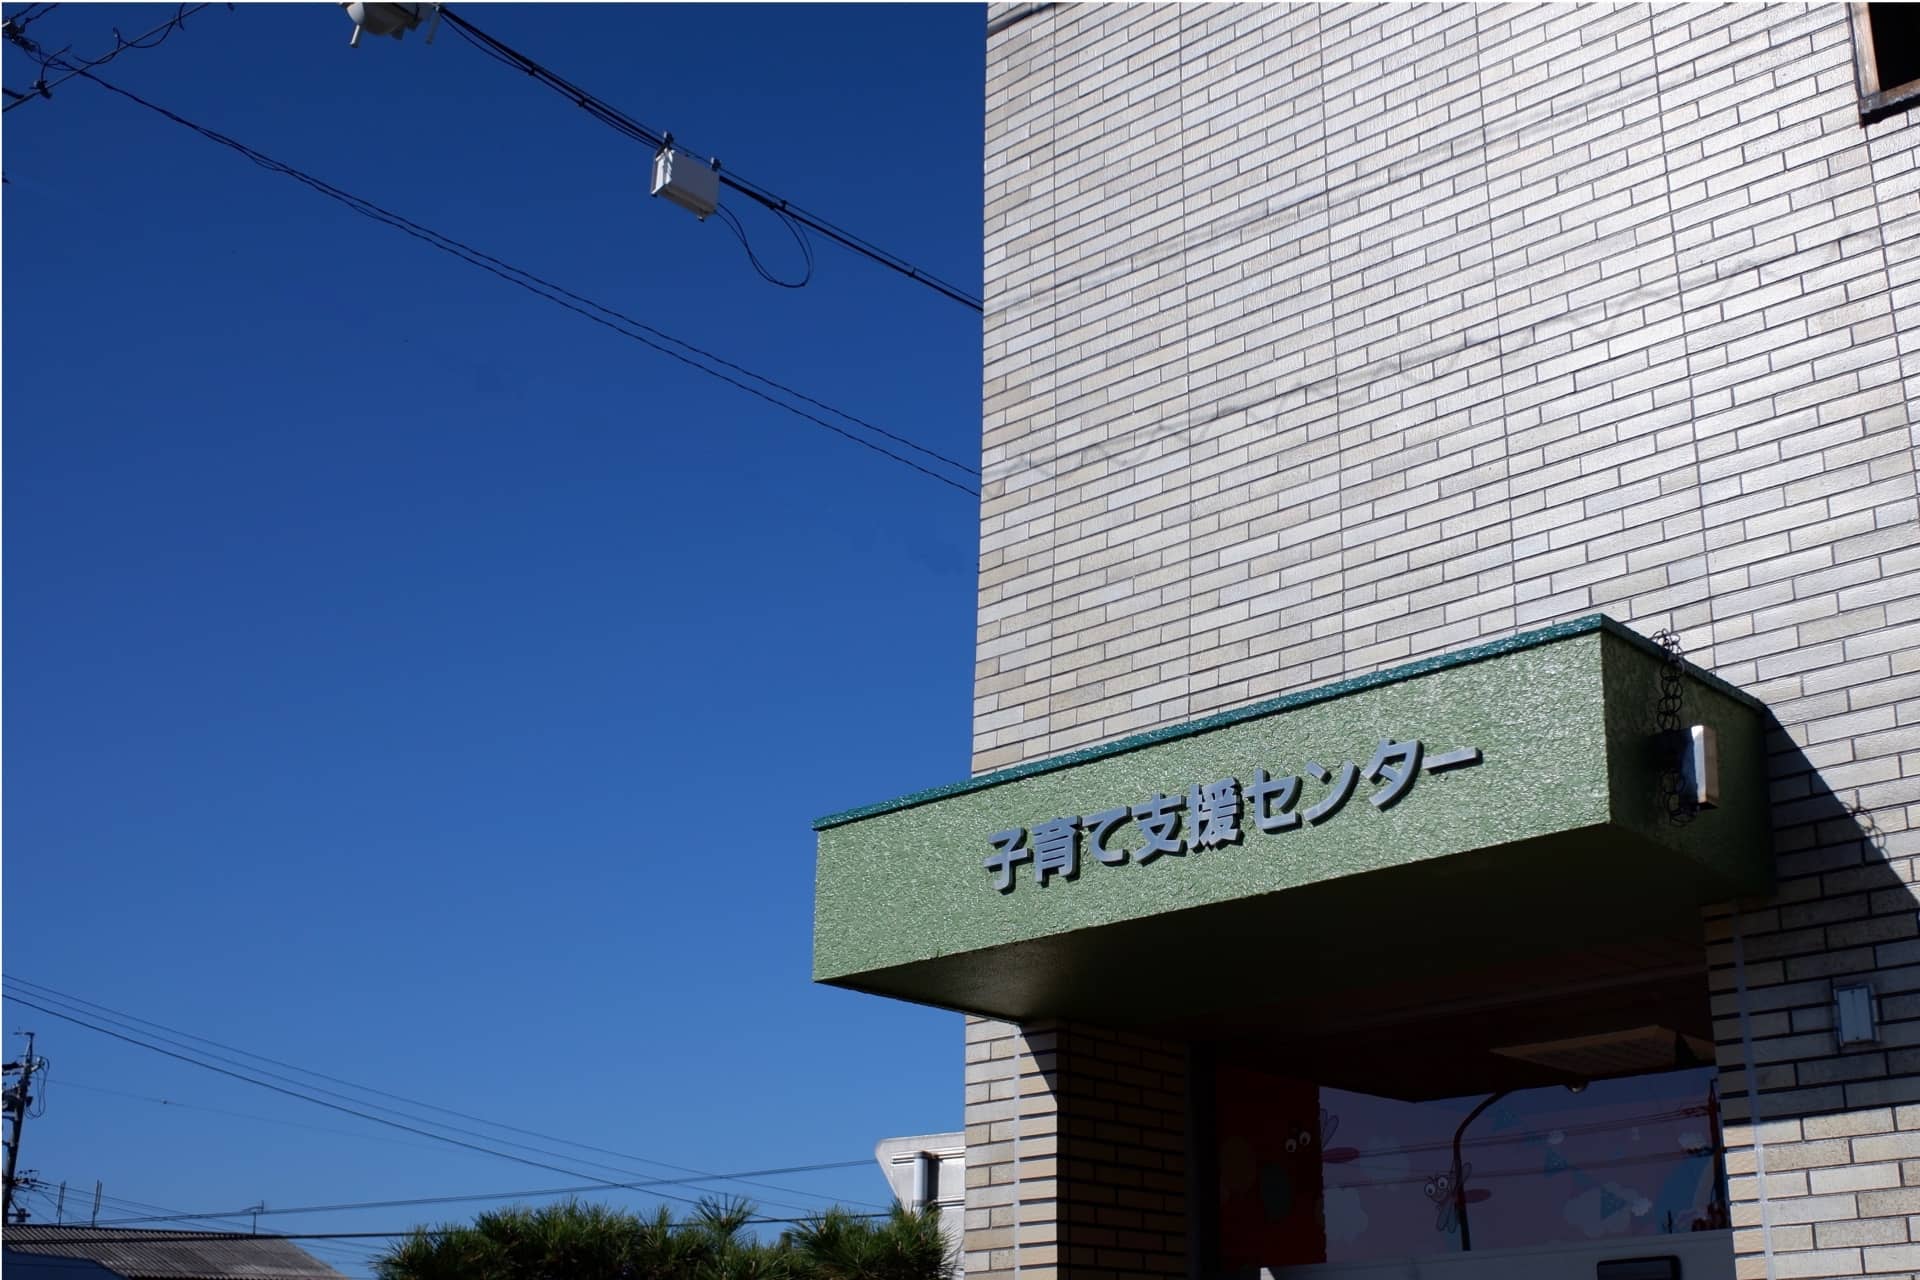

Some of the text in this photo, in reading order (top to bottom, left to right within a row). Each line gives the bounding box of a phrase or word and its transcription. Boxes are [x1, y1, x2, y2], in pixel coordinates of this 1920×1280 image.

[984, 737, 1482, 892] 子育て支援センター
